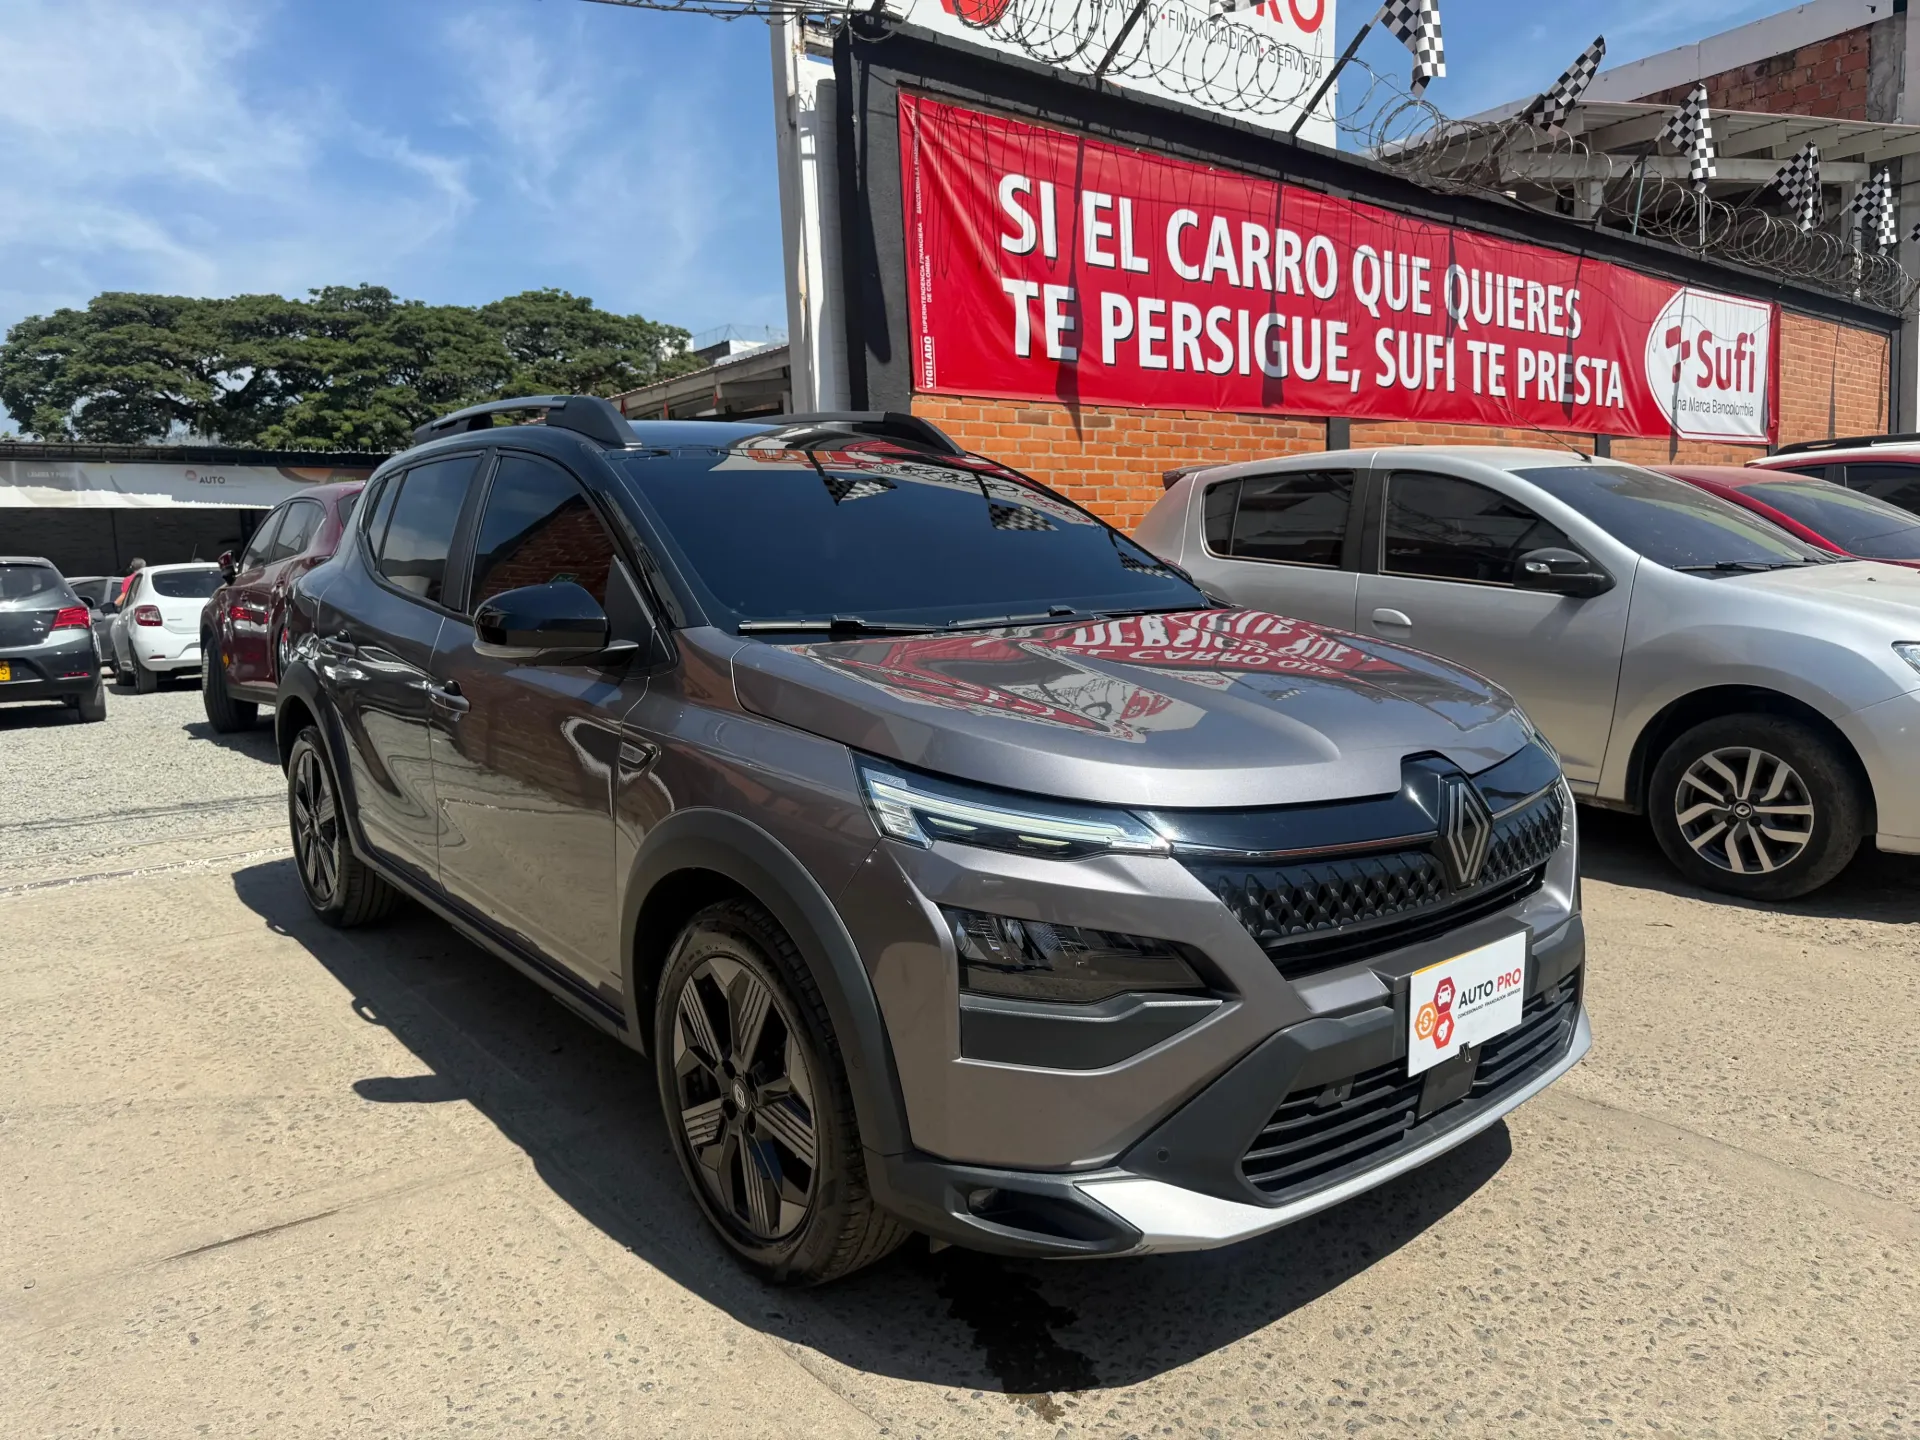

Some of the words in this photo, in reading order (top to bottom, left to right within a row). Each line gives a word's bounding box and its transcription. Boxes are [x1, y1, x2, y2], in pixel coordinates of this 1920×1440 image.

[1268, 45, 1322, 79] SERVICIO
[917, 222, 925, 265] FINANCIERA
[998, 173, 1058, 261] SI
[1082, 189, 1149, 274] EL
[1166, 208, 1339, 300] CARRO
[1353, 244, 1432, 319] QUE
[1444, 263, 1582, 340] QUIERES
[920, 265, 929, 334] SUPERINTENDENCIA
[926, 292, 933, 303] DE
[924, 335, 934, 388] VIGILADO
[1000, 277, 1078, 361] TE
[1101, 291, 1361, 393] PERSIGUE,
[1375, 327, 1456, 393] SUFI
[1467, 340, 1506, 398] TE
[1517, 347, 1625, 410] PRESTA
[1697, 330, 1756, 393] Sufi
[1672, 396, 1687, 412] Una
[1688, 397, 1711, 413] Marca
[1712, 399, 1754, 417] Bancolombia
[199, 476, 225, 485] AUTO
[1458, 980, 1493, 1009] AUTO
[1497, 968, 1521, 992] PRO
